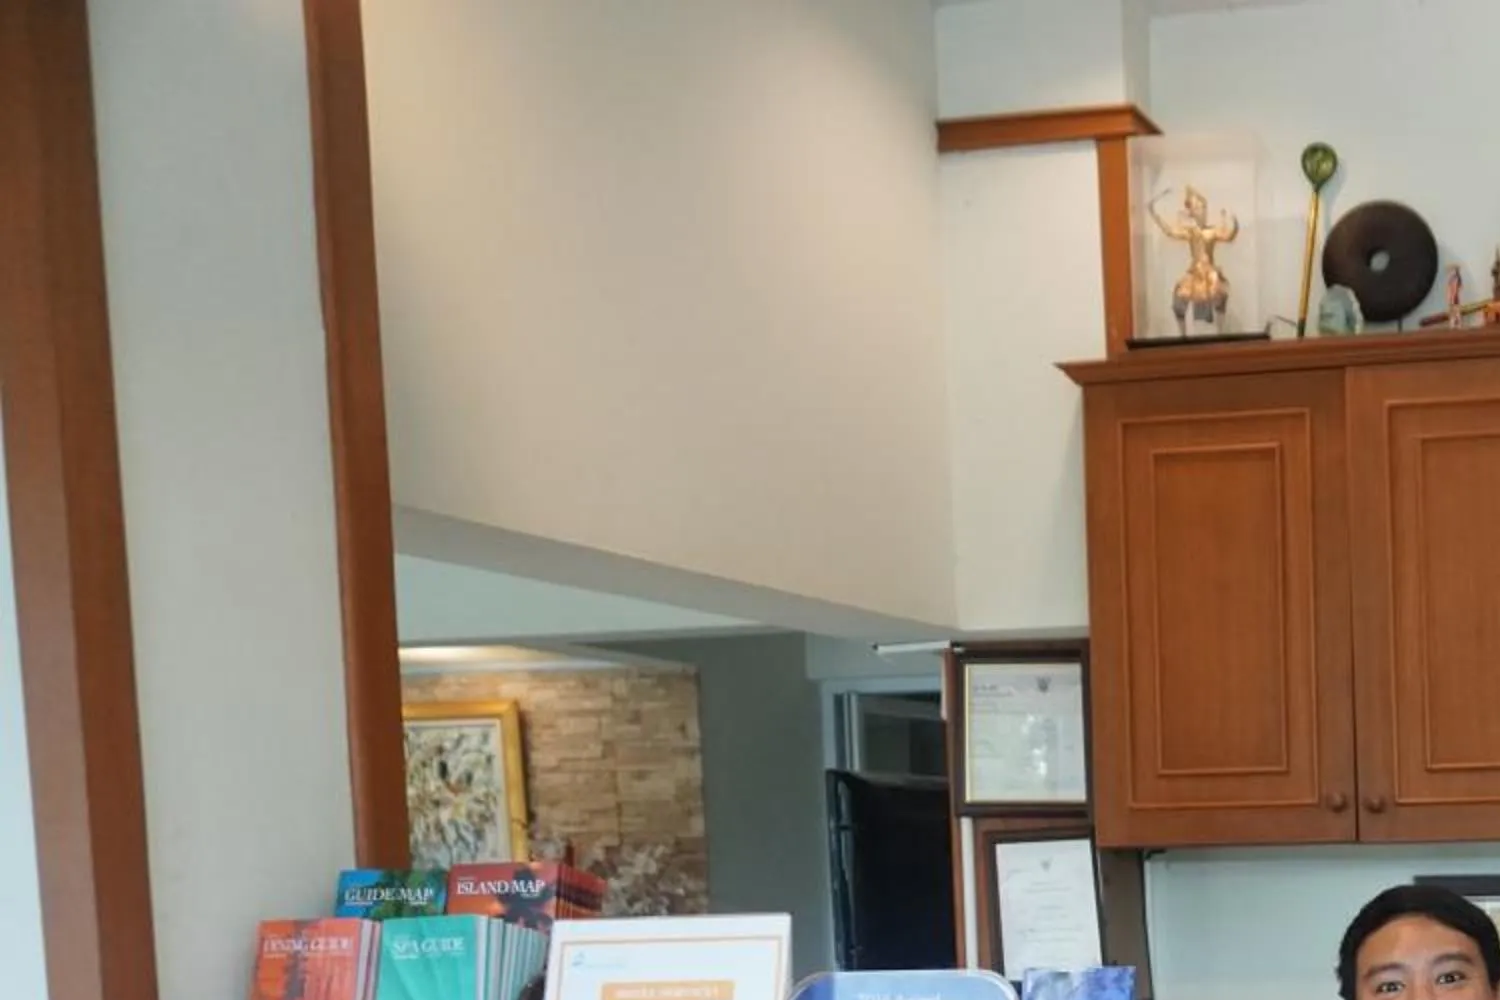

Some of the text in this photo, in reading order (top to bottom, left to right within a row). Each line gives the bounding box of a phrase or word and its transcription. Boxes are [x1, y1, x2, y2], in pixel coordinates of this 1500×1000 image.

[345, 887, 435, 902] GUIDE MAP
[457, 879, 547, 896] ISLAND MAP
[393, 937, 465, 953] SPA GUIDE
